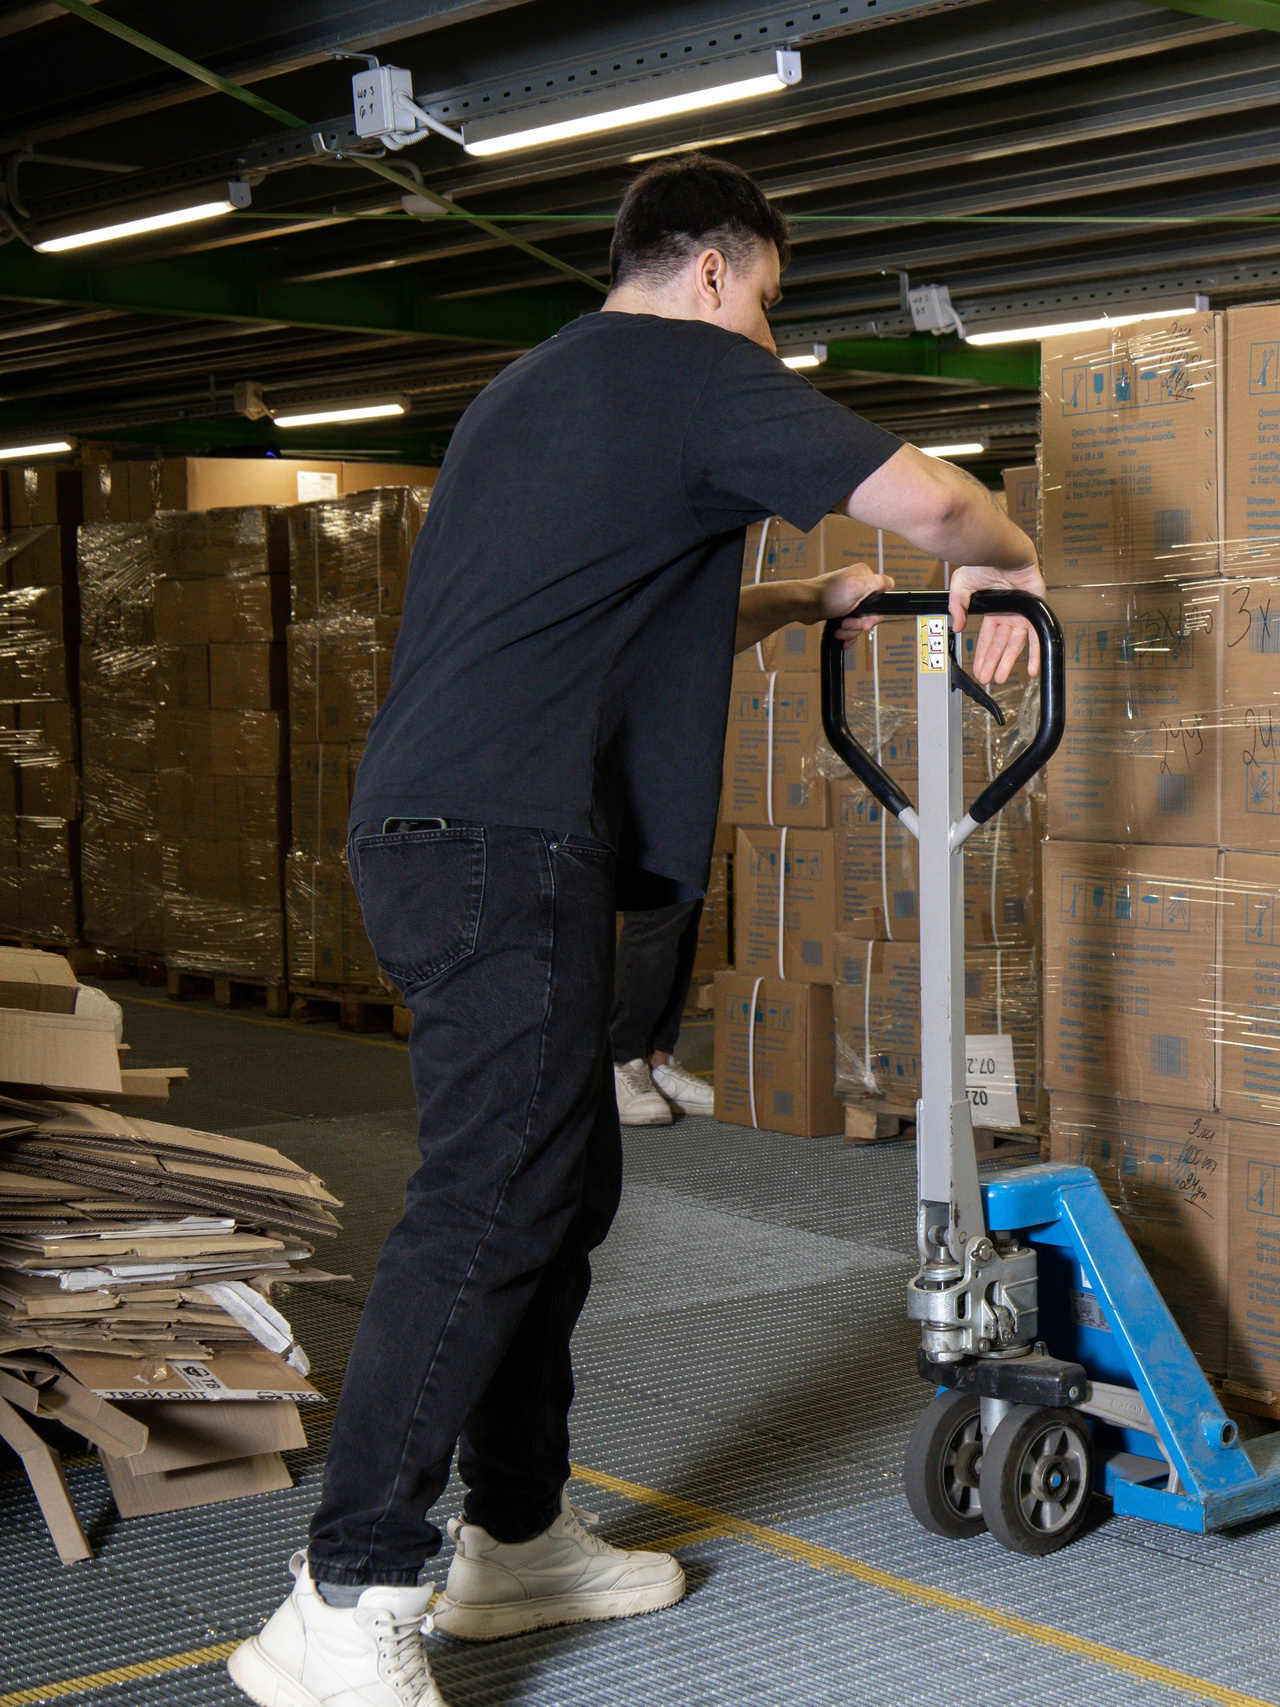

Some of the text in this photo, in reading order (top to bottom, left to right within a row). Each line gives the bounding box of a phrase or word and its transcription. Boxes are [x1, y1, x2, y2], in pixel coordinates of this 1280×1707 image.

[1258, 422, 1280, 431] Carton
[1258, 436, 1266, 444] 58
[1271, 435, 1280, 443] 38
[1246, 496, 1276, 506] Шприцы
[1255, 986, 1264, 994] 58
[1268, 988, 1277, 996] 38
[1256, 1241, 1277, 1253] Carton
[167, 1391, 208, 1400] ОПТ
